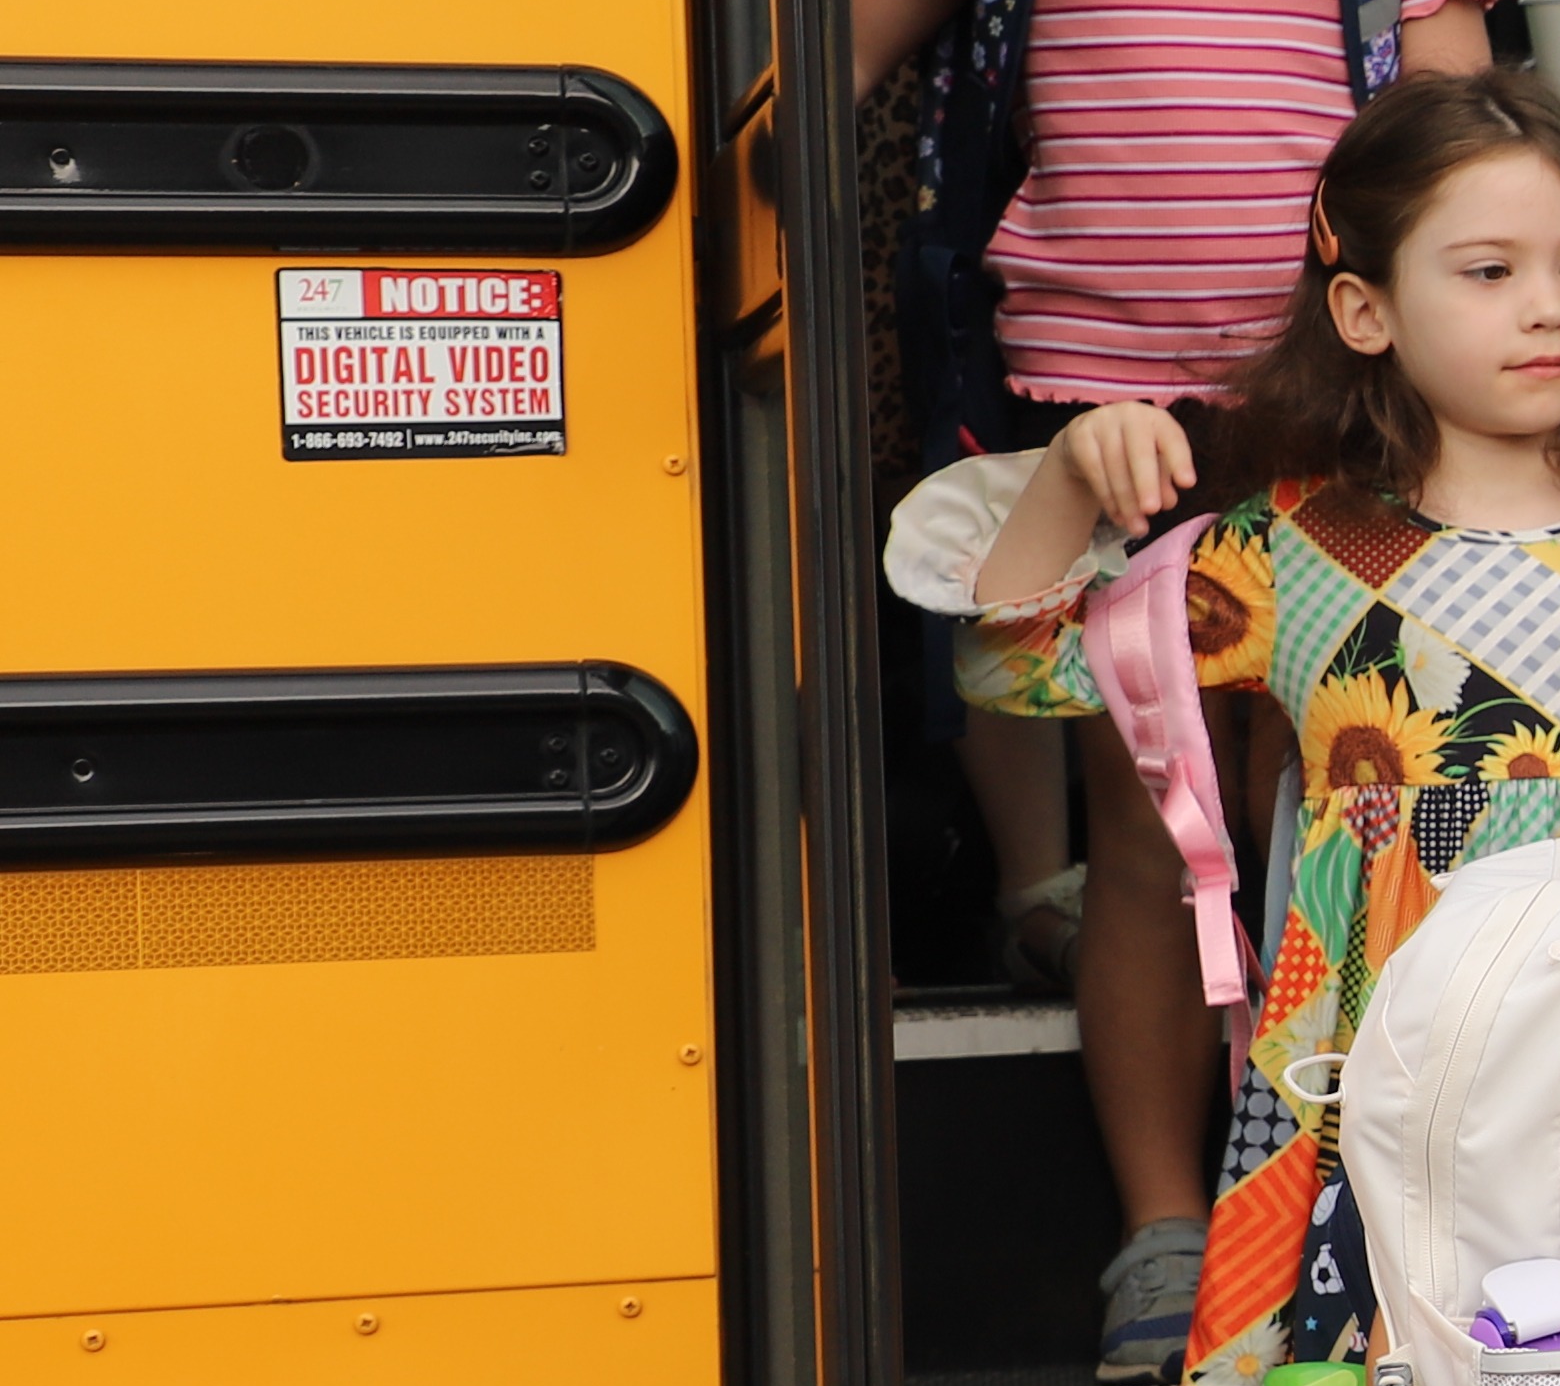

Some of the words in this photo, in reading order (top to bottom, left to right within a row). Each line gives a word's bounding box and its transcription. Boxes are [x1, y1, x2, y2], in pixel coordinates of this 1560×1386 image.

[299, 278, 343, 302] 247
[380, 276, 542, 313] NOTICE:
[297, 327, 330, 341] THIS
[335, 327, 394, 341] VEHICLE
[400, 327, 413, 341] IS
[419, 327, 490, 341] EQUIPPED
[496, 327, 530, 340] WITH
[535, 327, 544, 340] A
[294, 345, 436, 385] DIGITAL
[448, 345, 549, 383] VIDEO
[296, 389, 433, 419] SECURITY
[444, 387, 550, 417] SYSTEM
[290, 432, 404, 449] 1-866-693-7492
